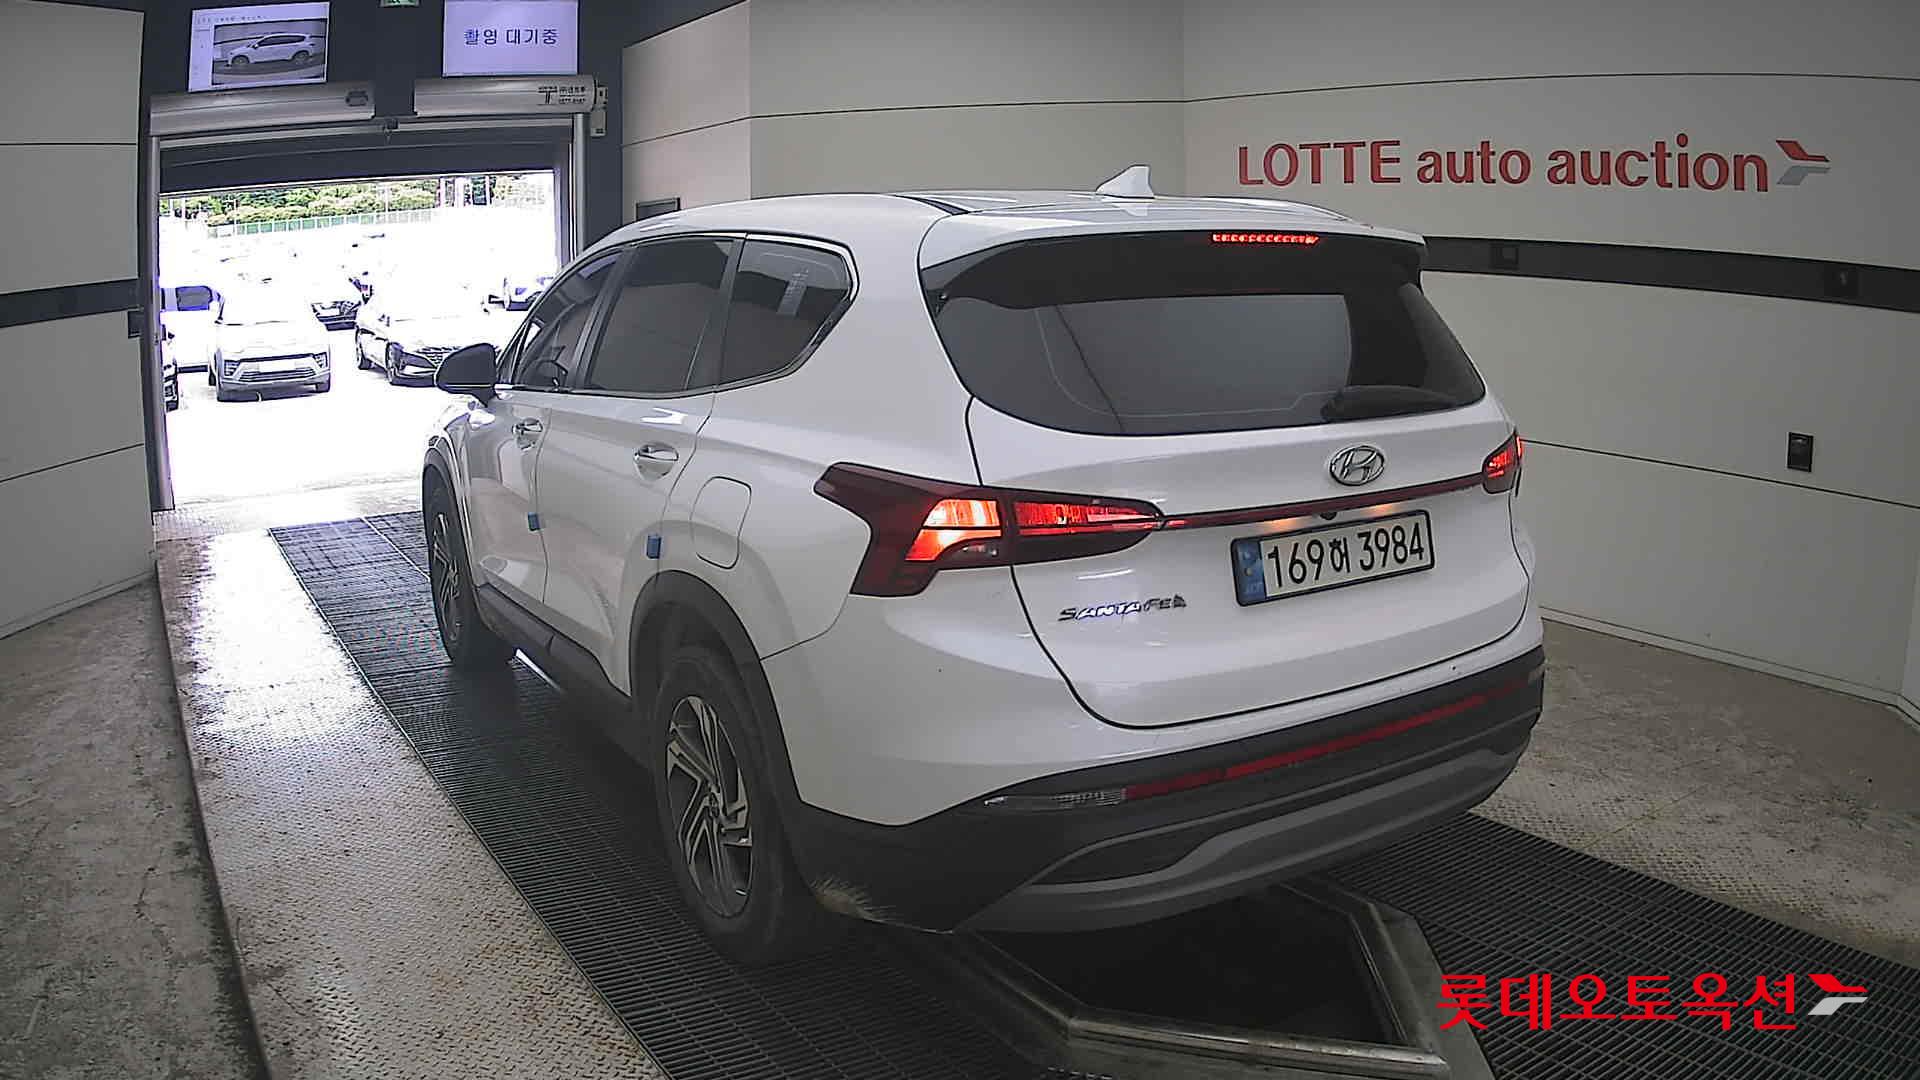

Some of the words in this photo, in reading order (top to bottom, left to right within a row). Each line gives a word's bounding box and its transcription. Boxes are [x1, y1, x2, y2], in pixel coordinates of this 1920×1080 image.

[464, 28, 498, 46] 촬영
[506, 28, 560, 45] 대기중
[1239, 140, 1400, 186] LOTTE
[1417, 140, 1531, 184] auto
[1547, 133, 1768, 192] auction
[1267, 537, 1350, 588] 169허
[1357, 522, 1425, 571] 3984
[1058, 601, 1141, 621] SANTA
